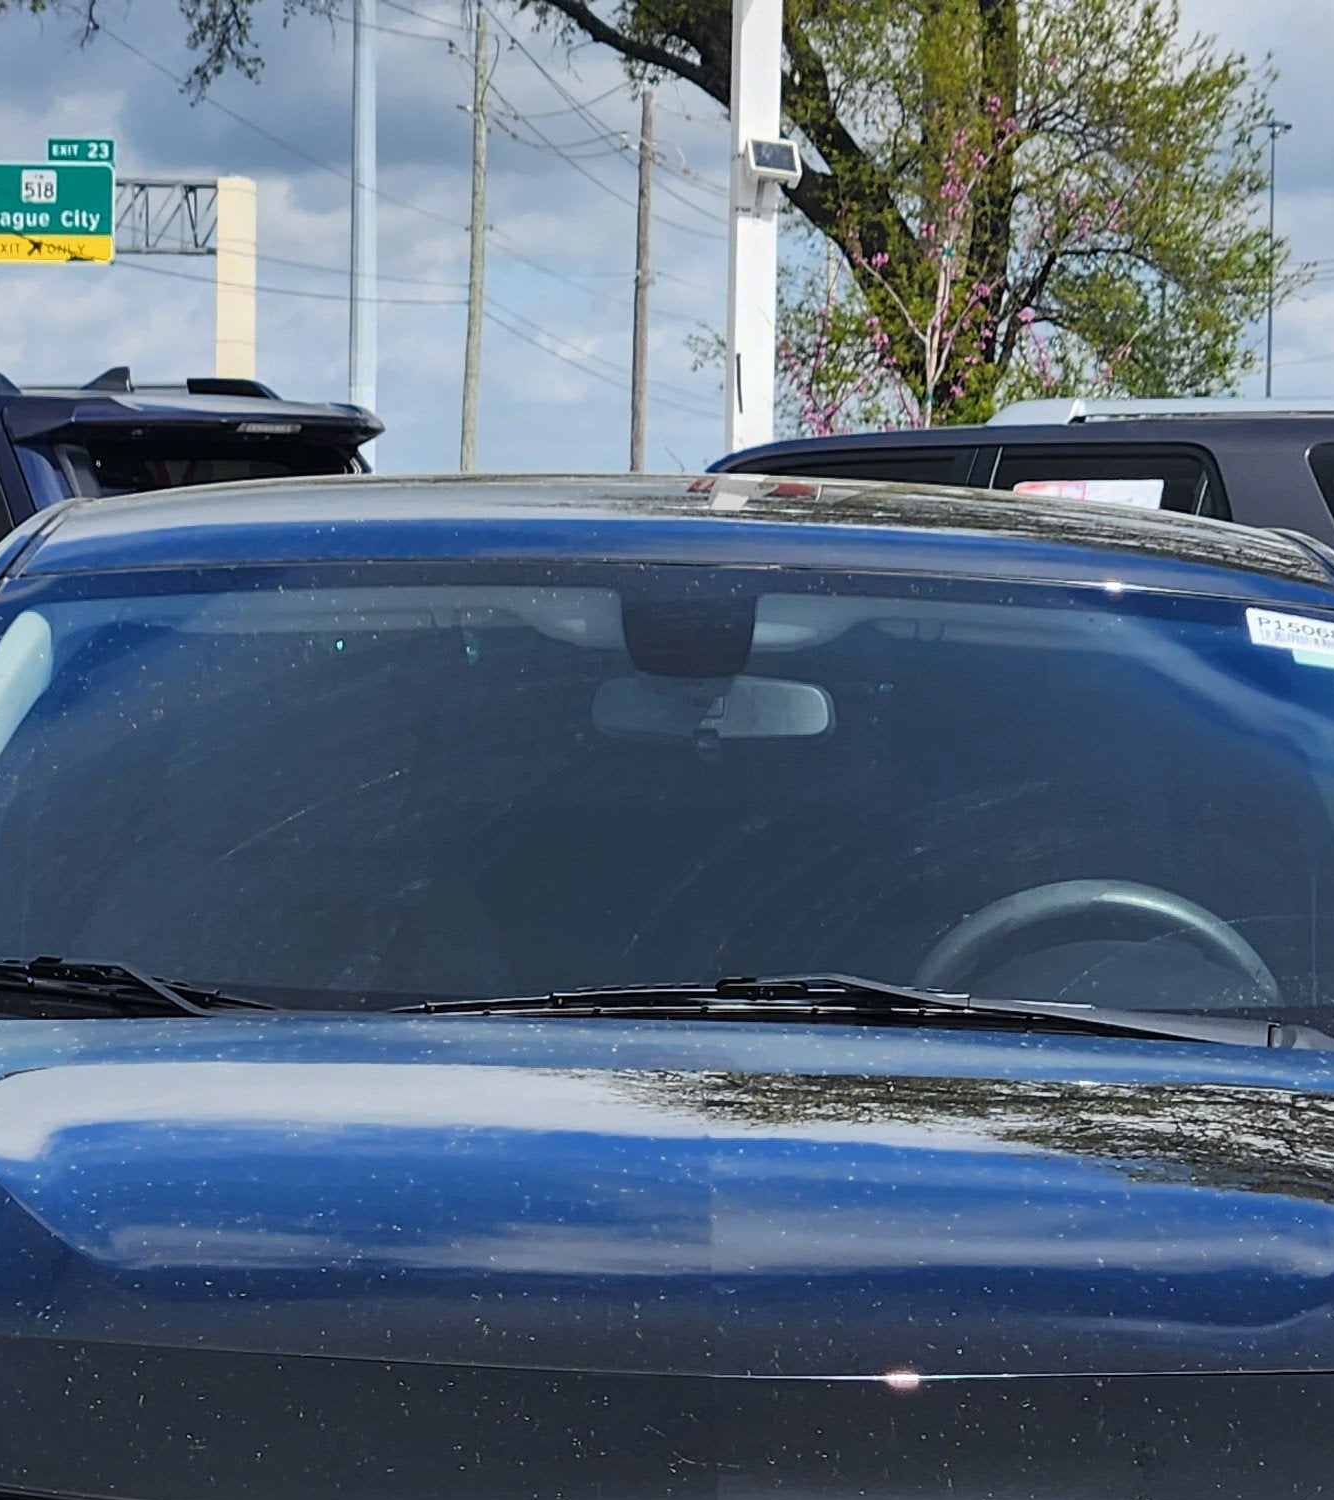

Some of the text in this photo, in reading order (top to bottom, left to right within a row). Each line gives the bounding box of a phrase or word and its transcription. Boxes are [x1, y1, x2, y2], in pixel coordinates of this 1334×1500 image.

[52, 142, 109, 159] EXIT 23
[24, 182, 54, 199] 518
[61, 209, 101, 231] City
[47, 243, 85, 254] ONLY
